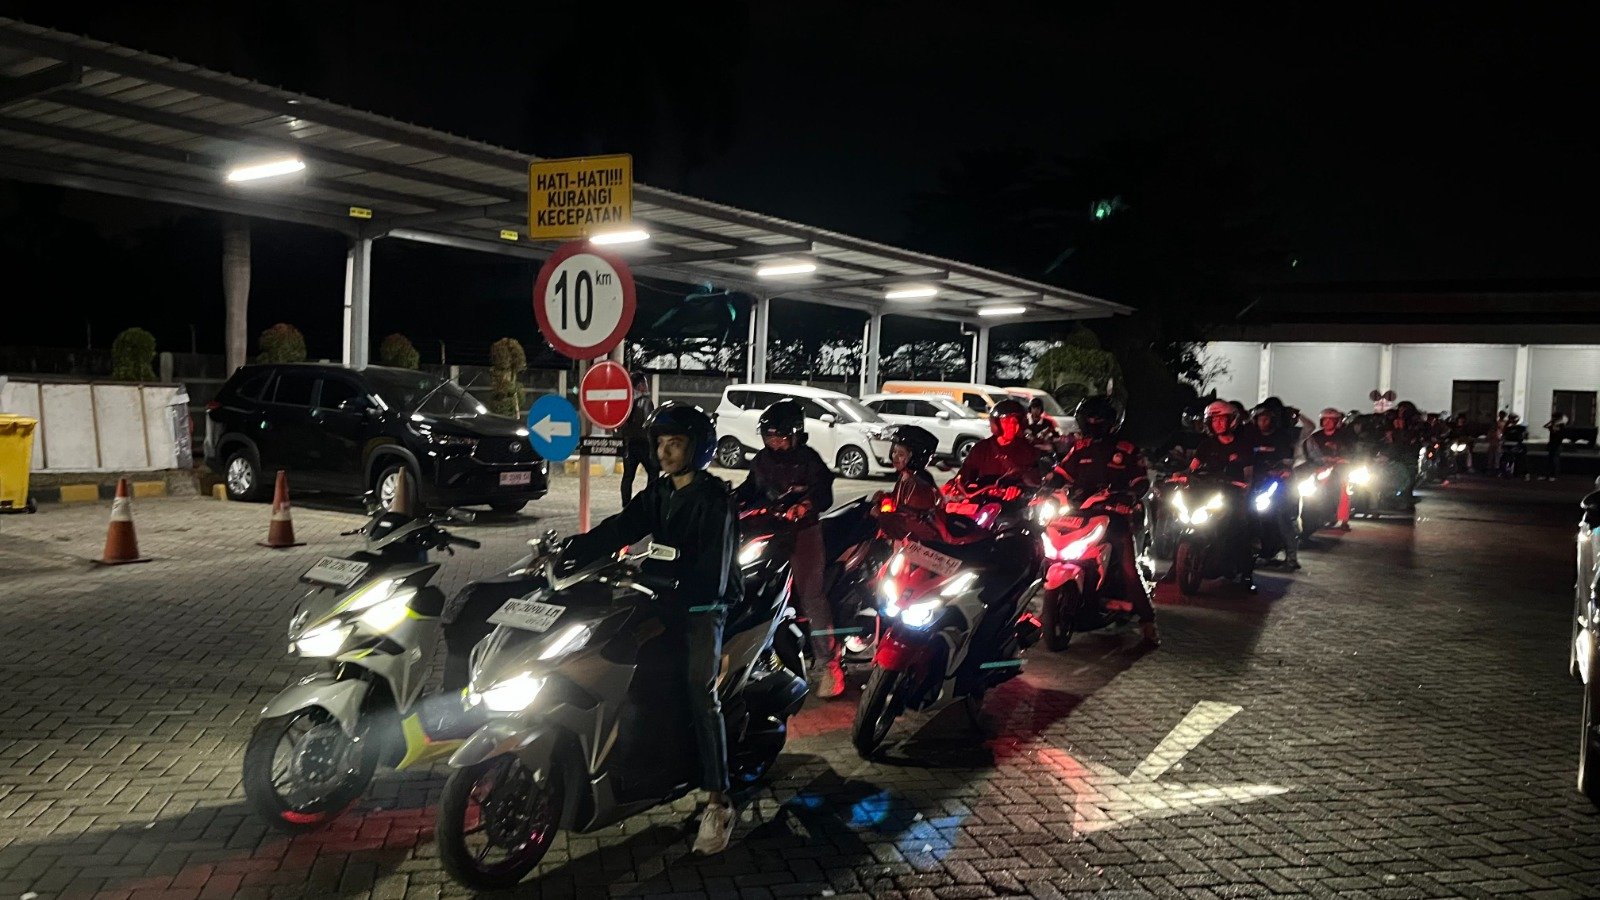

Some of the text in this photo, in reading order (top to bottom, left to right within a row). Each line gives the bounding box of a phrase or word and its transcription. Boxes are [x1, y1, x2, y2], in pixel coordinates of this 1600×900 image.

[537, 168, 623, 191] HATI-HATI!!!
[547, 188, 612, 208] KURANGI
[537, 206, 622, 227] KECEPATAN
[555, 270, 612, 331] 10 km
